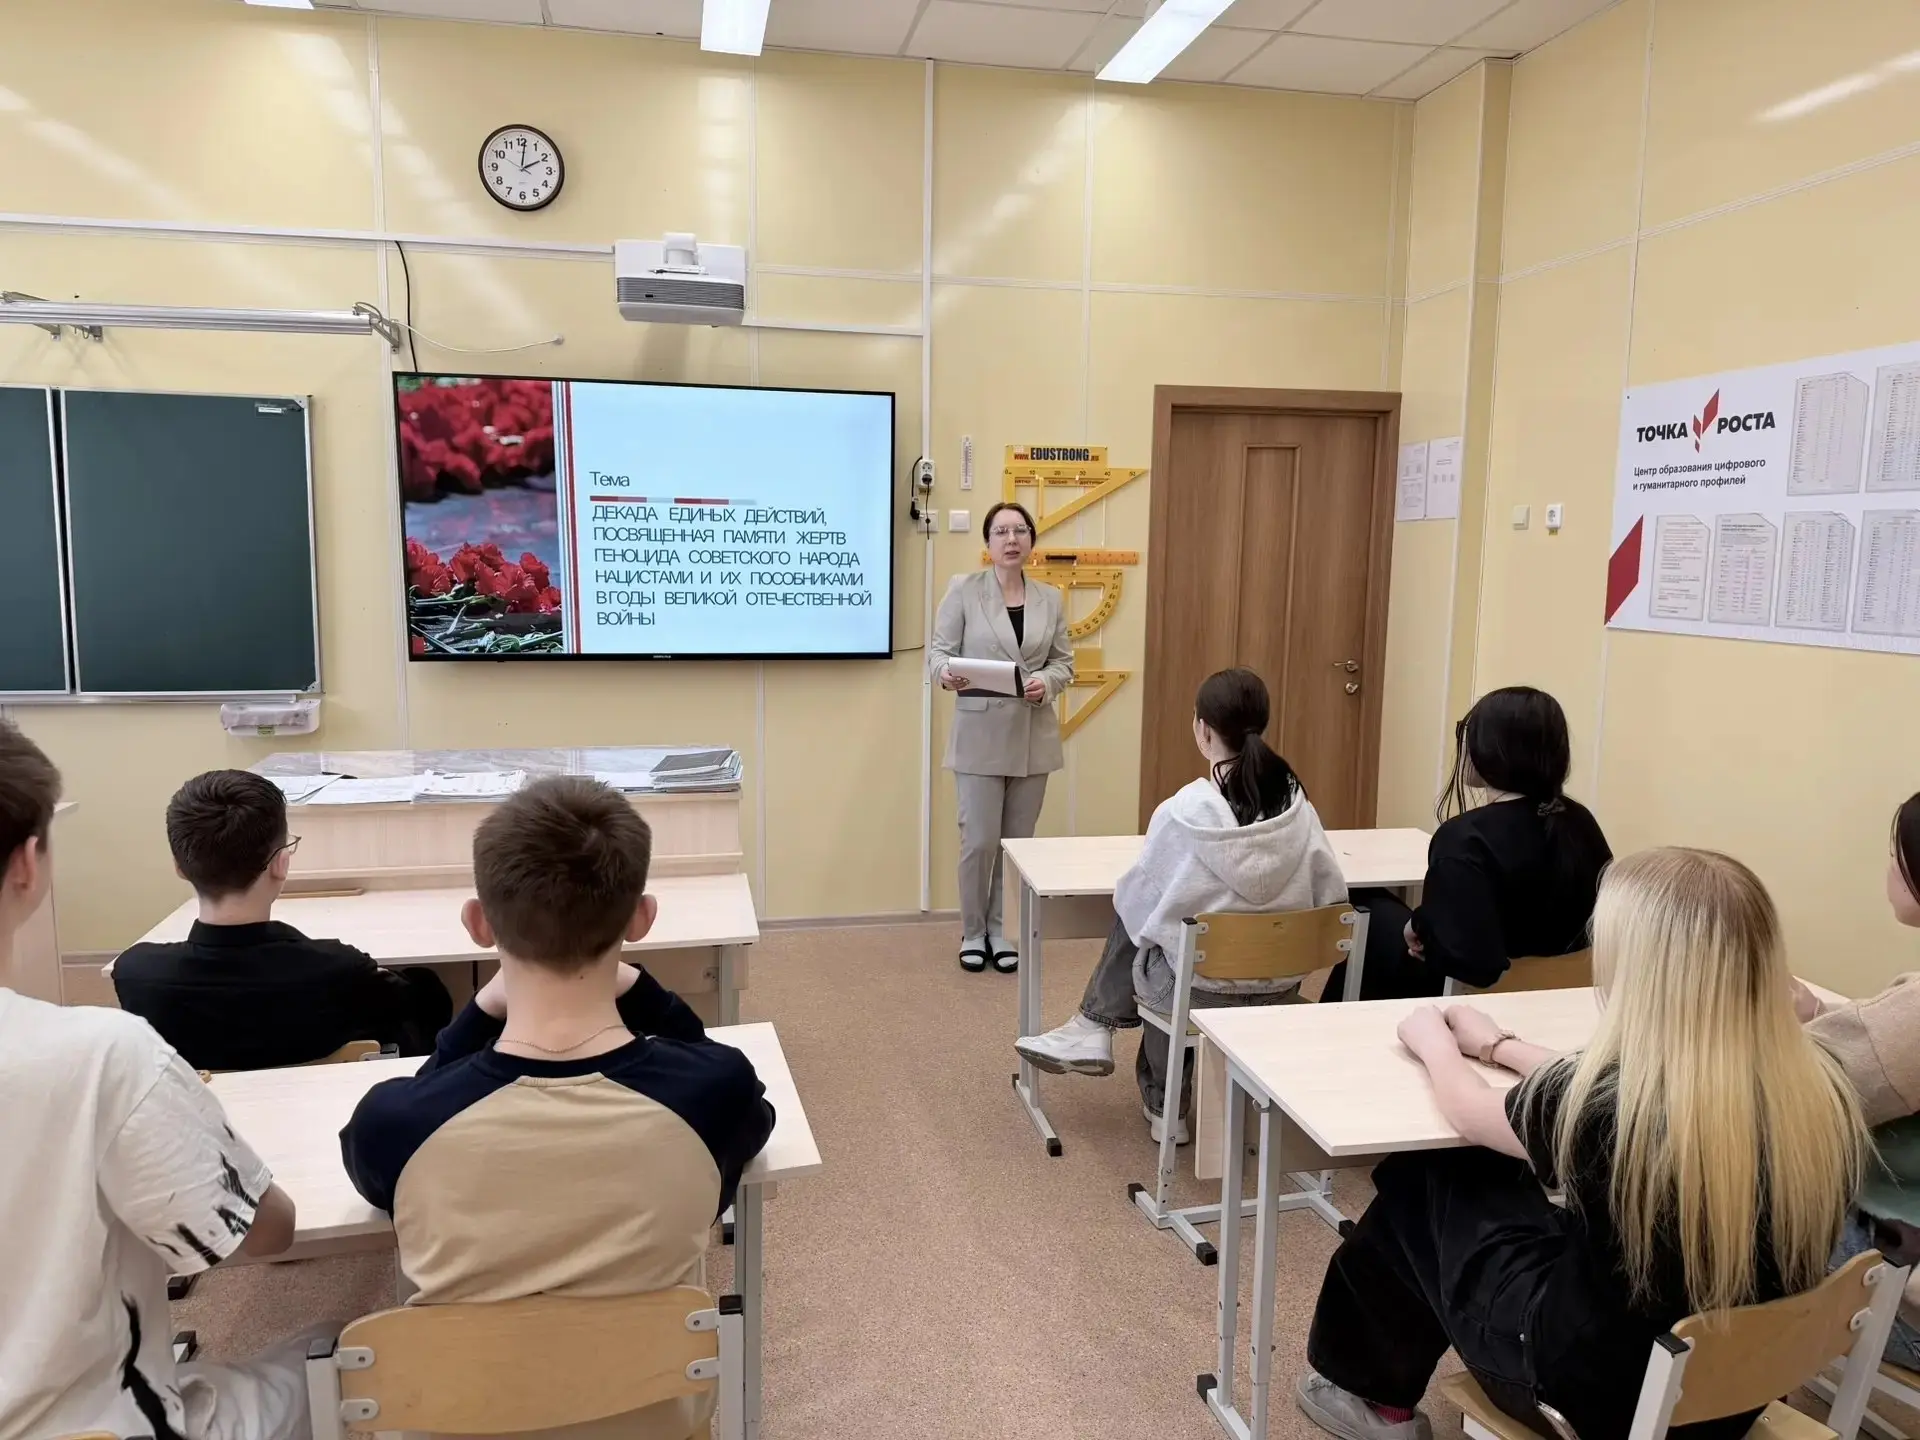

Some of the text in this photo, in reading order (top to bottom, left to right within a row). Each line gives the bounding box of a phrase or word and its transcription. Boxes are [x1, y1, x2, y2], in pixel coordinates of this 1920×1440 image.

[504, 140, 513, 149] 11
[516, 138, 527, 147] 12
[494, 150, 506, 159] 10
[541, 153, 548, 162] 2
[491, 162, 498, 171] 9
[546, 167, 553, 175] 3
[496, 176, 503, 185] 8
[541, 180, 549, 188] 4
[505, 187, 512, 196] 7
[519, 191, 526, 200] 6
[532, 189, 539, 197] 5
[1636, 411, 1775, 442] ТОЧКА РОСТА
[1634, 459, 1766, 477] Центр образования цифрового
[588, 471, 630, 487] Тема
[1639, 478, 1698, 492] гуманитарного
[1700, 475, 1746, 488] профилей
[592, 506, 827, 527] ДЕКАДА ЕДИНЫХ ДЕЙСТВИЙ,
[593, 527, 847, 545] ПОСВЯЩЕННАЯ ПАМЯТИ ЖЕРТВ
[594, 548, 860, 568] ГЕНОЦИДА СОВЕТСКОГО НАРОДА
[595, 570, 863, 586] НАЦИСТАМИ И ИХ ПОСОБНИКАМИ
[664, 589, 737, 605] ВЕЛИКОЙ
[745, 590, 872, 606] ОТЕЧЕСТВЕННОЙ
[596, 609, 655, 625] ВОЙНЫ
